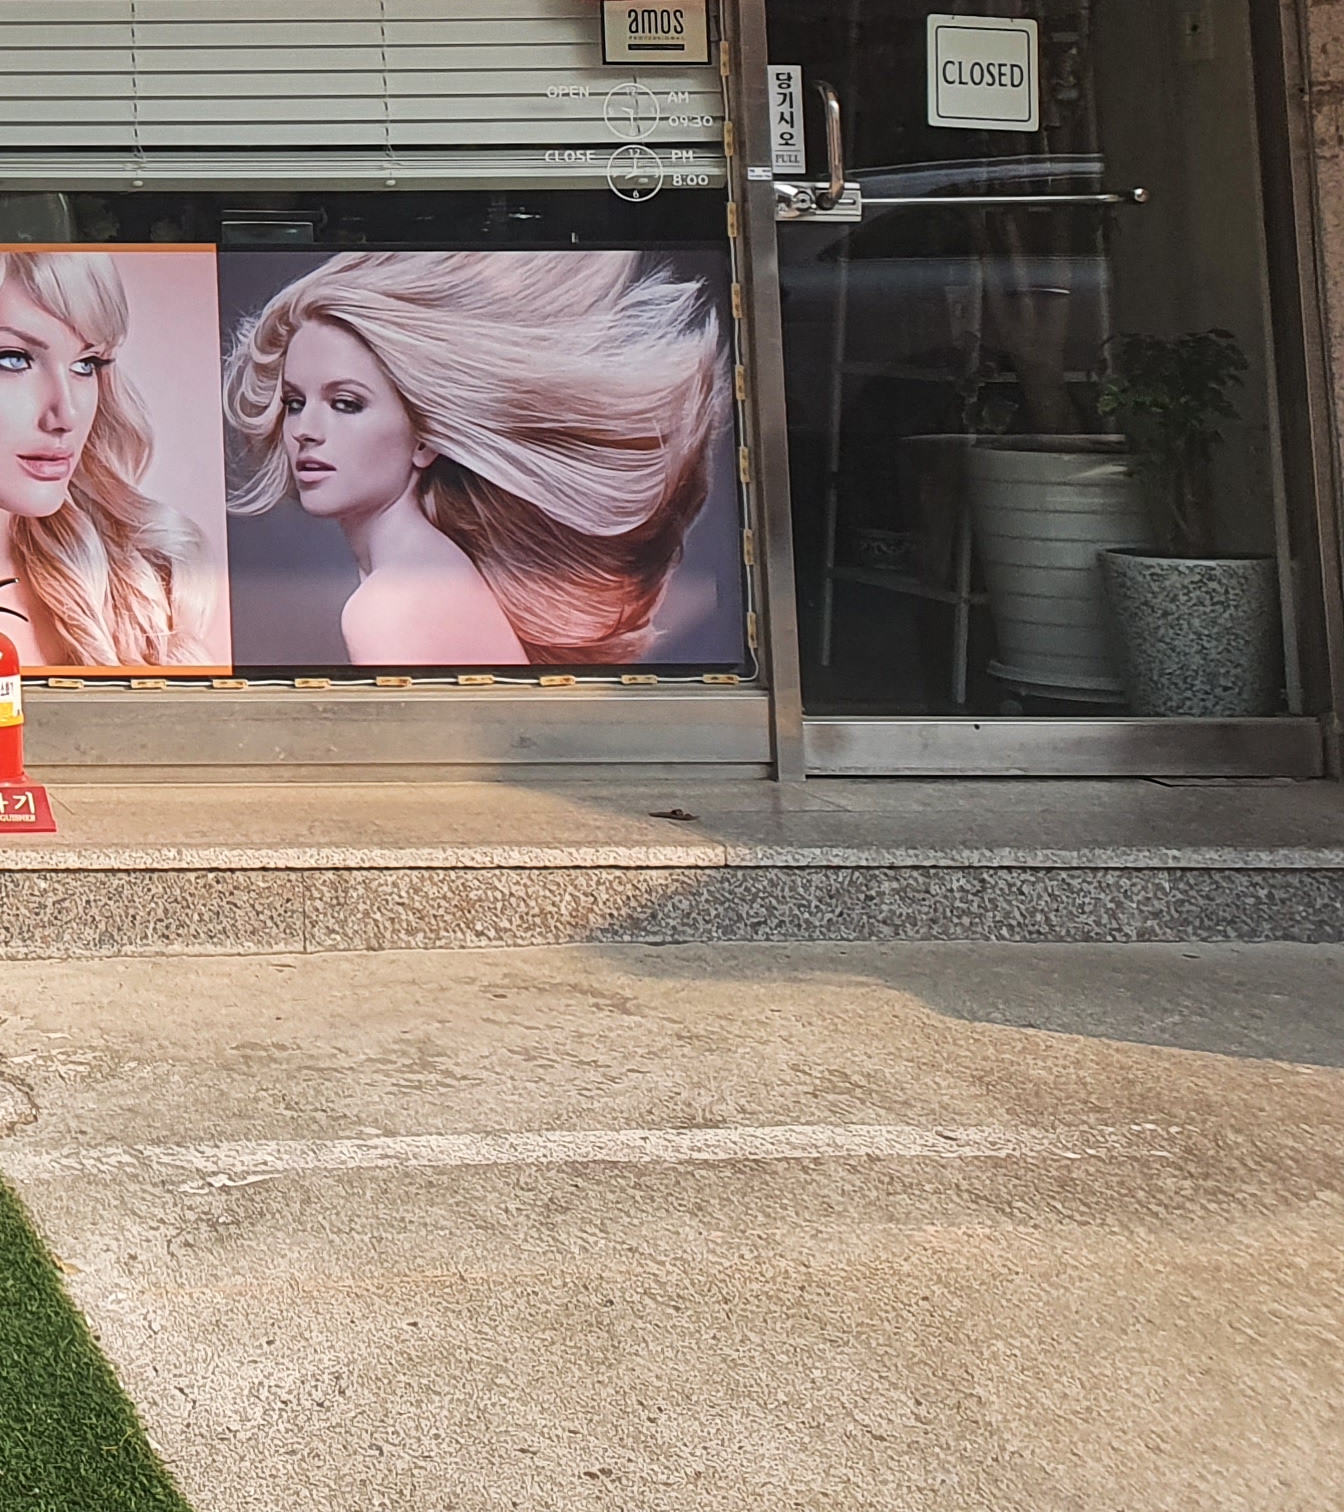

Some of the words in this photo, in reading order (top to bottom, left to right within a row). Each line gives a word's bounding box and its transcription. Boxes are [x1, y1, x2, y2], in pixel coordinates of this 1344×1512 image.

[627, 8, 685, 35] amos
[941, 59, 1025, 89] CLOSED
[546, 85, 590, 99] OPEN
[667, 91, 690, 103] AM
[775, 72, 797, 147] 당기시오
[544, 150, 596, 163] CLOSE
[671, 150, 694, 163] PM
[775, 153, 800, 164] PULL
[672, 174, 709, 186] 8:00
